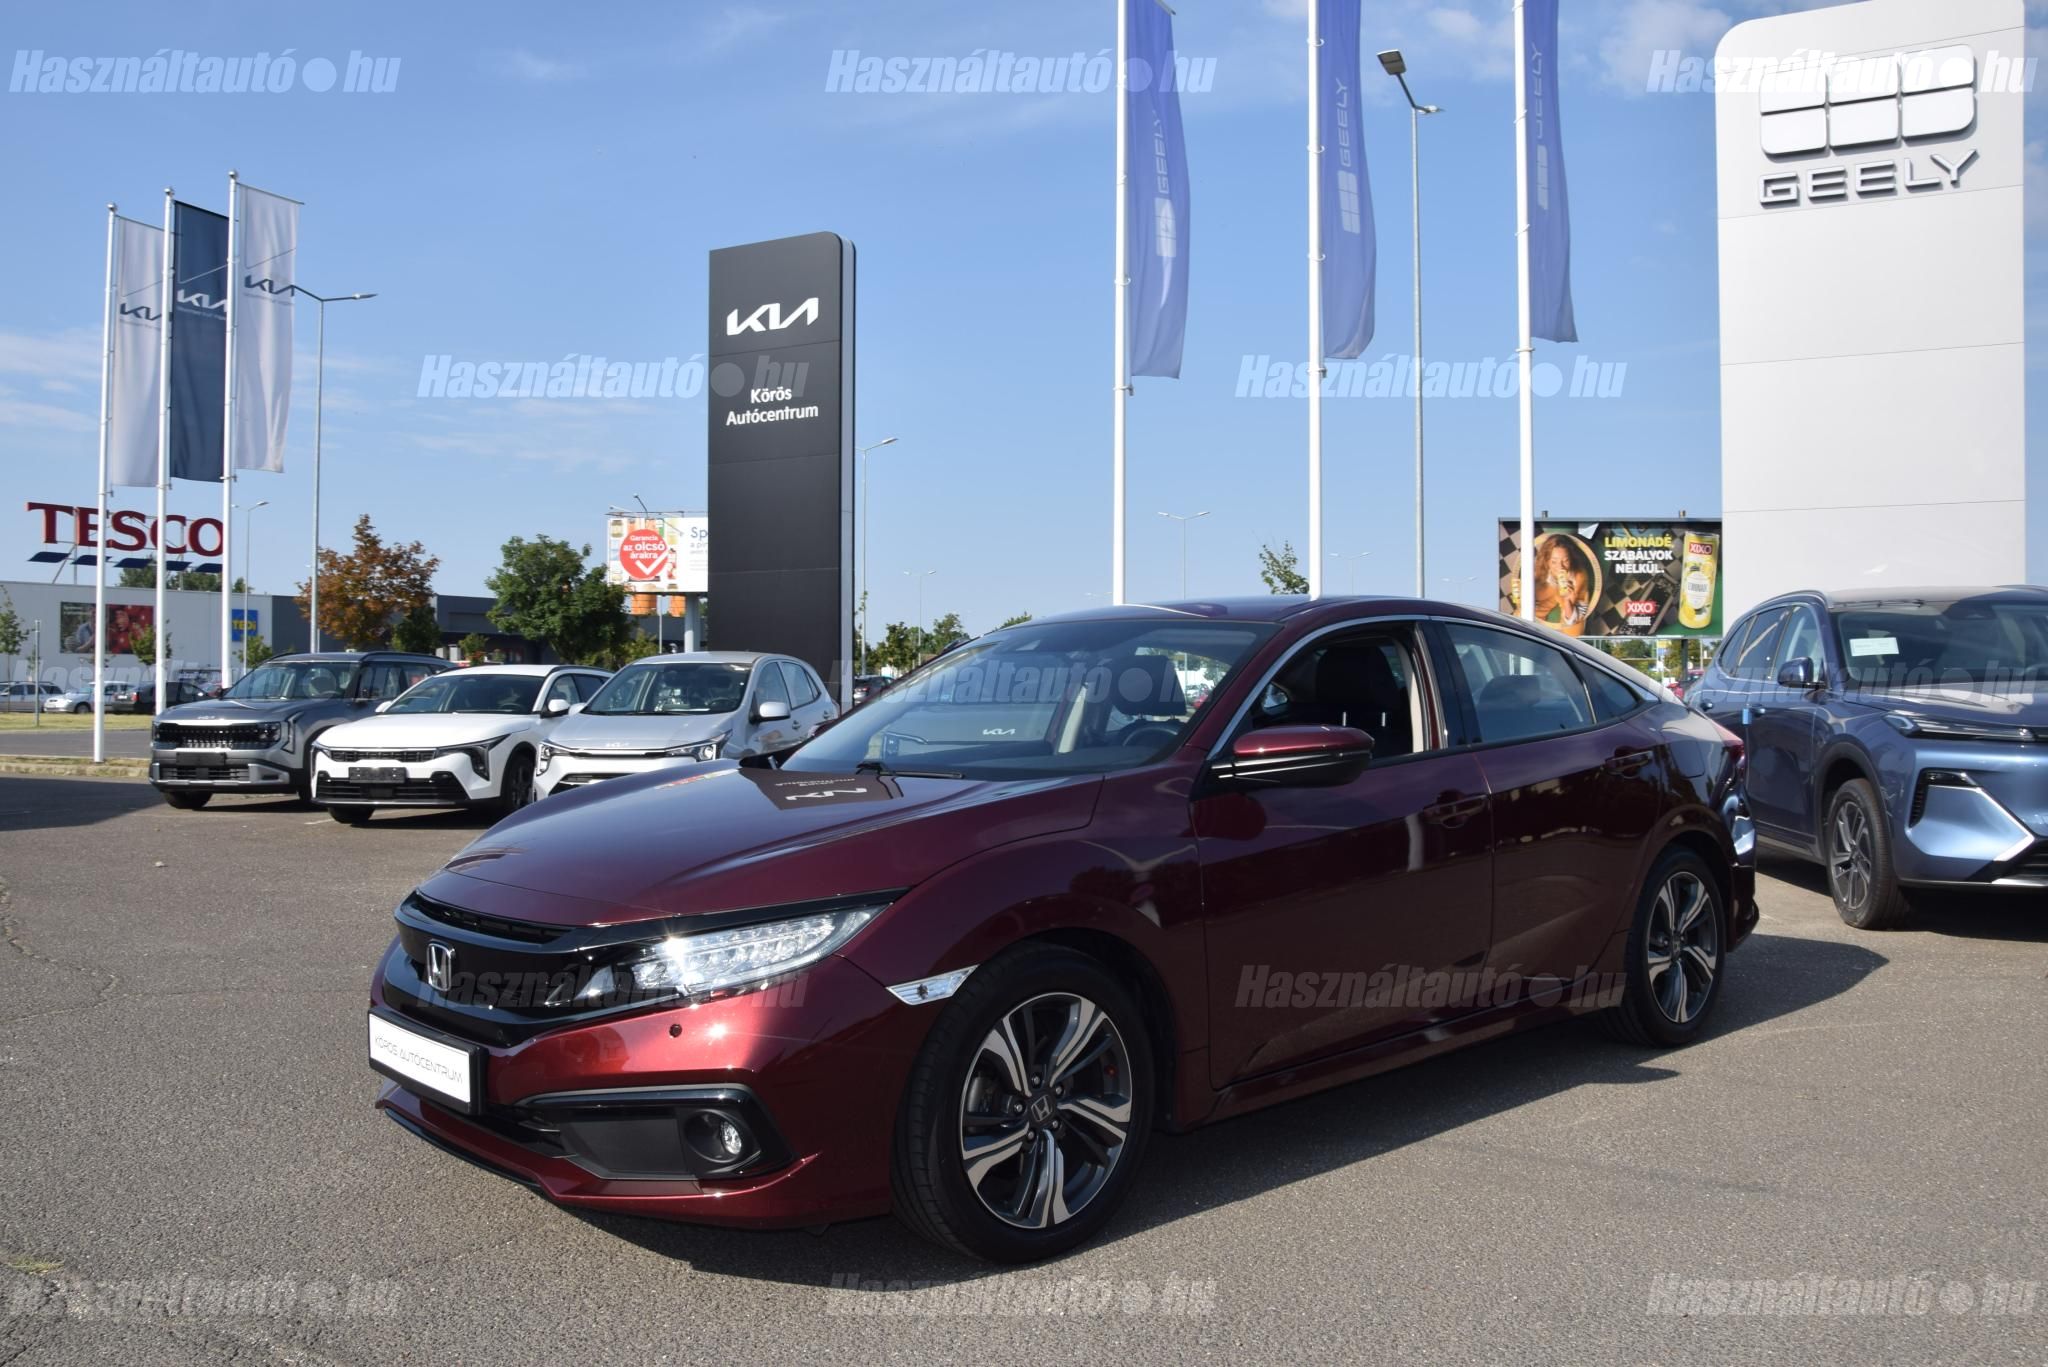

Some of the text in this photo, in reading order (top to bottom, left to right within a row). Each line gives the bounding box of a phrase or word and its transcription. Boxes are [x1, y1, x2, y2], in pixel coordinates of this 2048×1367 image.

[1336, 77, 1353, 167] GEELY
[1759, 149, 1978, 206] GEELY
[727, 298, 819, 335] KIA
[726, 406, 819, 426] Autócentrum
[26, 502, 224, 557] TESCO
[635, 541, 665, 551] olcsó
[1604, 548, 1673, 560] SZABÁLYOK
[1690, 543, 1712, 554] XIXO
[1627, 602, 1653, 613] XIXO
